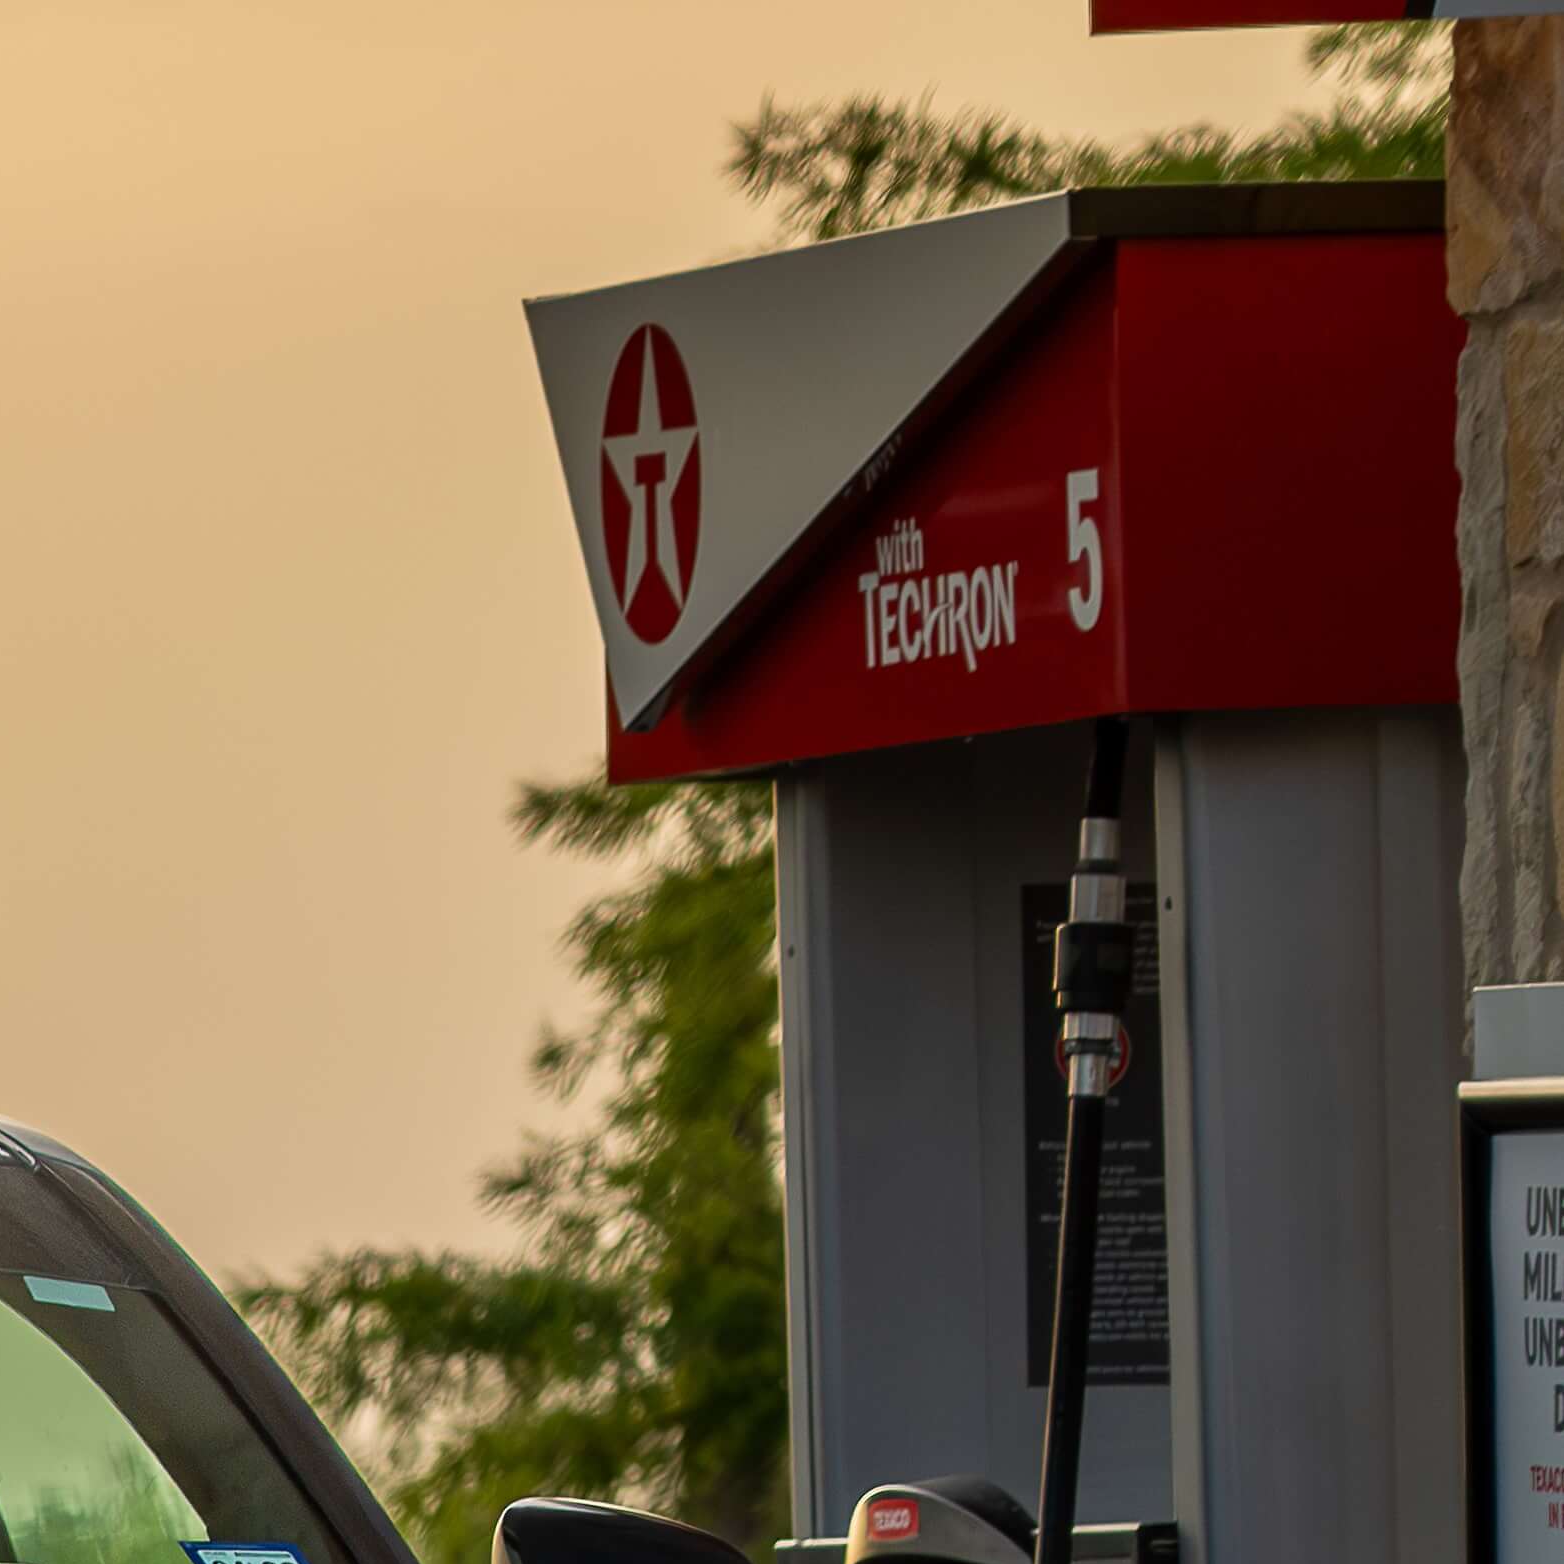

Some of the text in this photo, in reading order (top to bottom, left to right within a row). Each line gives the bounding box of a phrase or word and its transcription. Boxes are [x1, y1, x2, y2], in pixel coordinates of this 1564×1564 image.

[876, 517, 924, 576] with
[1067, 469, 1103, 632] 5
[859, 562, 1017, 672] TECHRON
[1530, 1464, 1564, 1493] TEXAC
